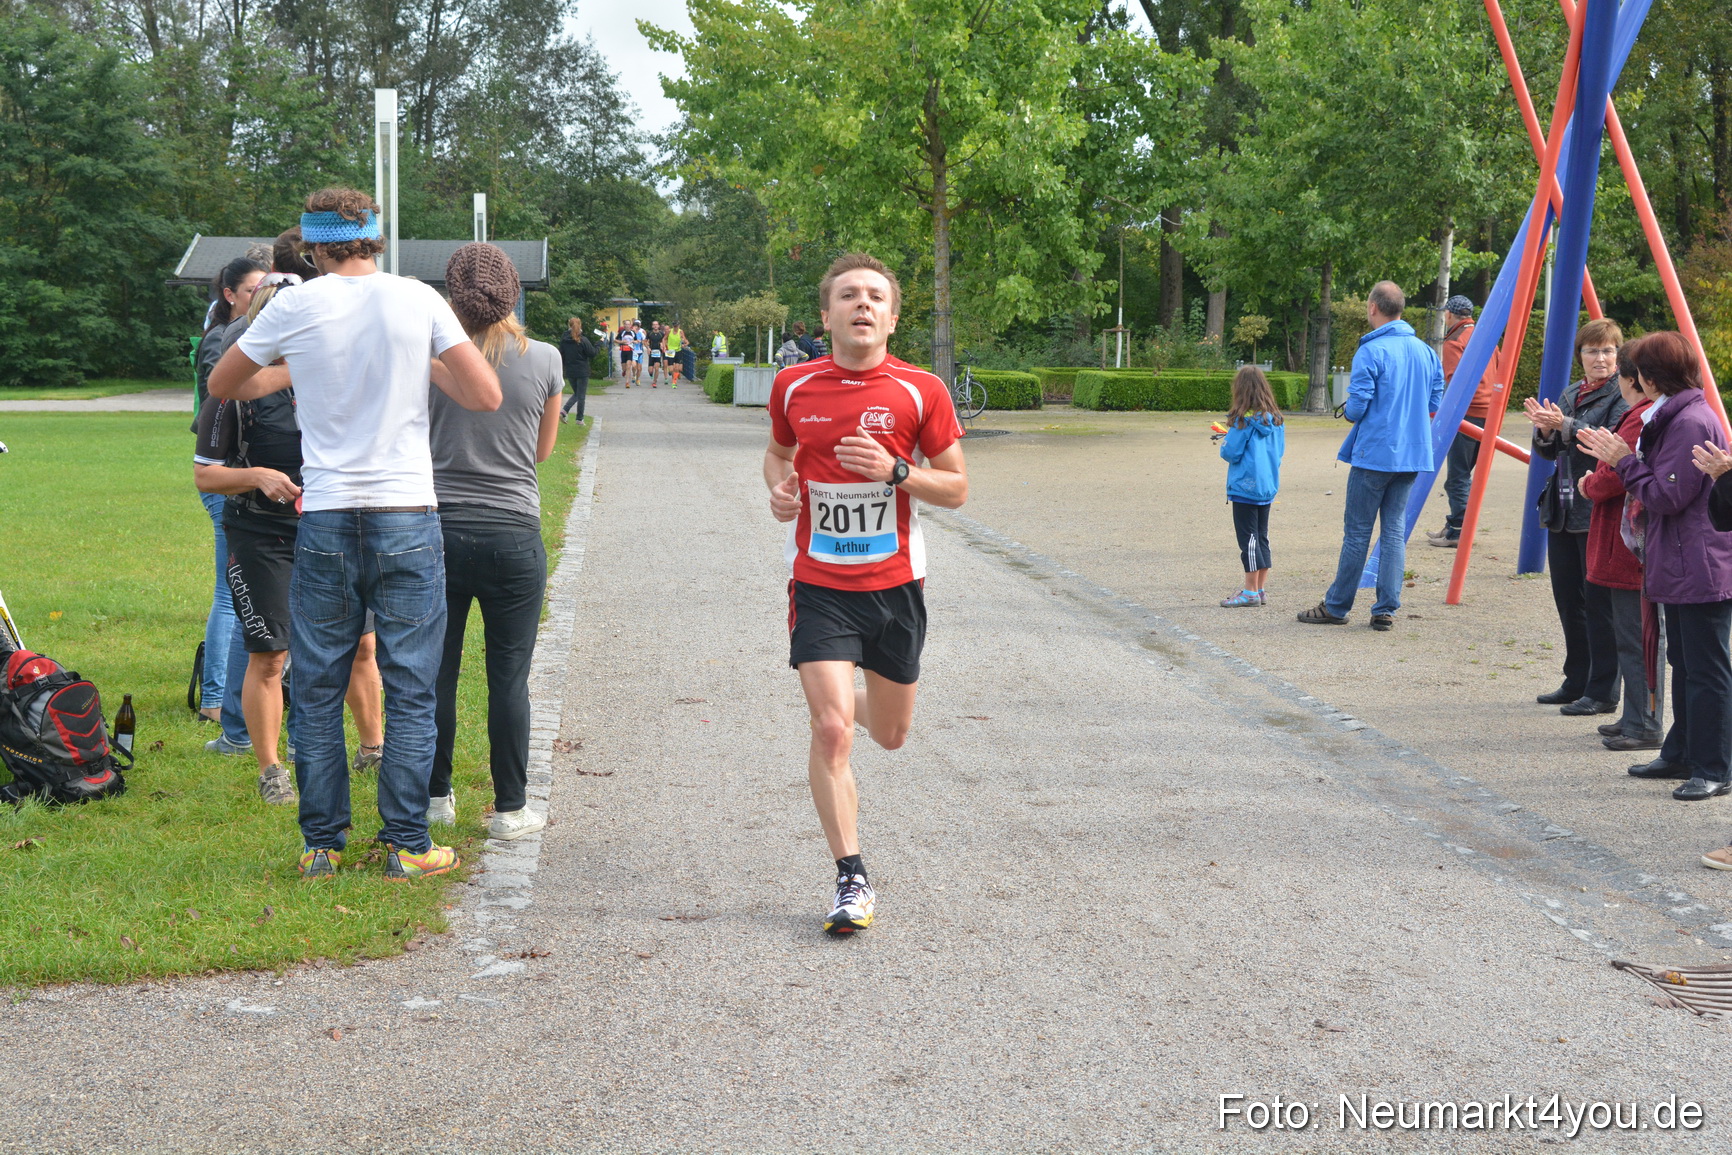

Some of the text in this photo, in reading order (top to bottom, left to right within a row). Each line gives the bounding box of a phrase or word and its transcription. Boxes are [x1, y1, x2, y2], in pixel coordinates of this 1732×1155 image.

[810, 488, 880, 500] PARTL Neumarkt
[818, 501, 888, 534] 2017
[835, 541, 871, 553] Arthur
